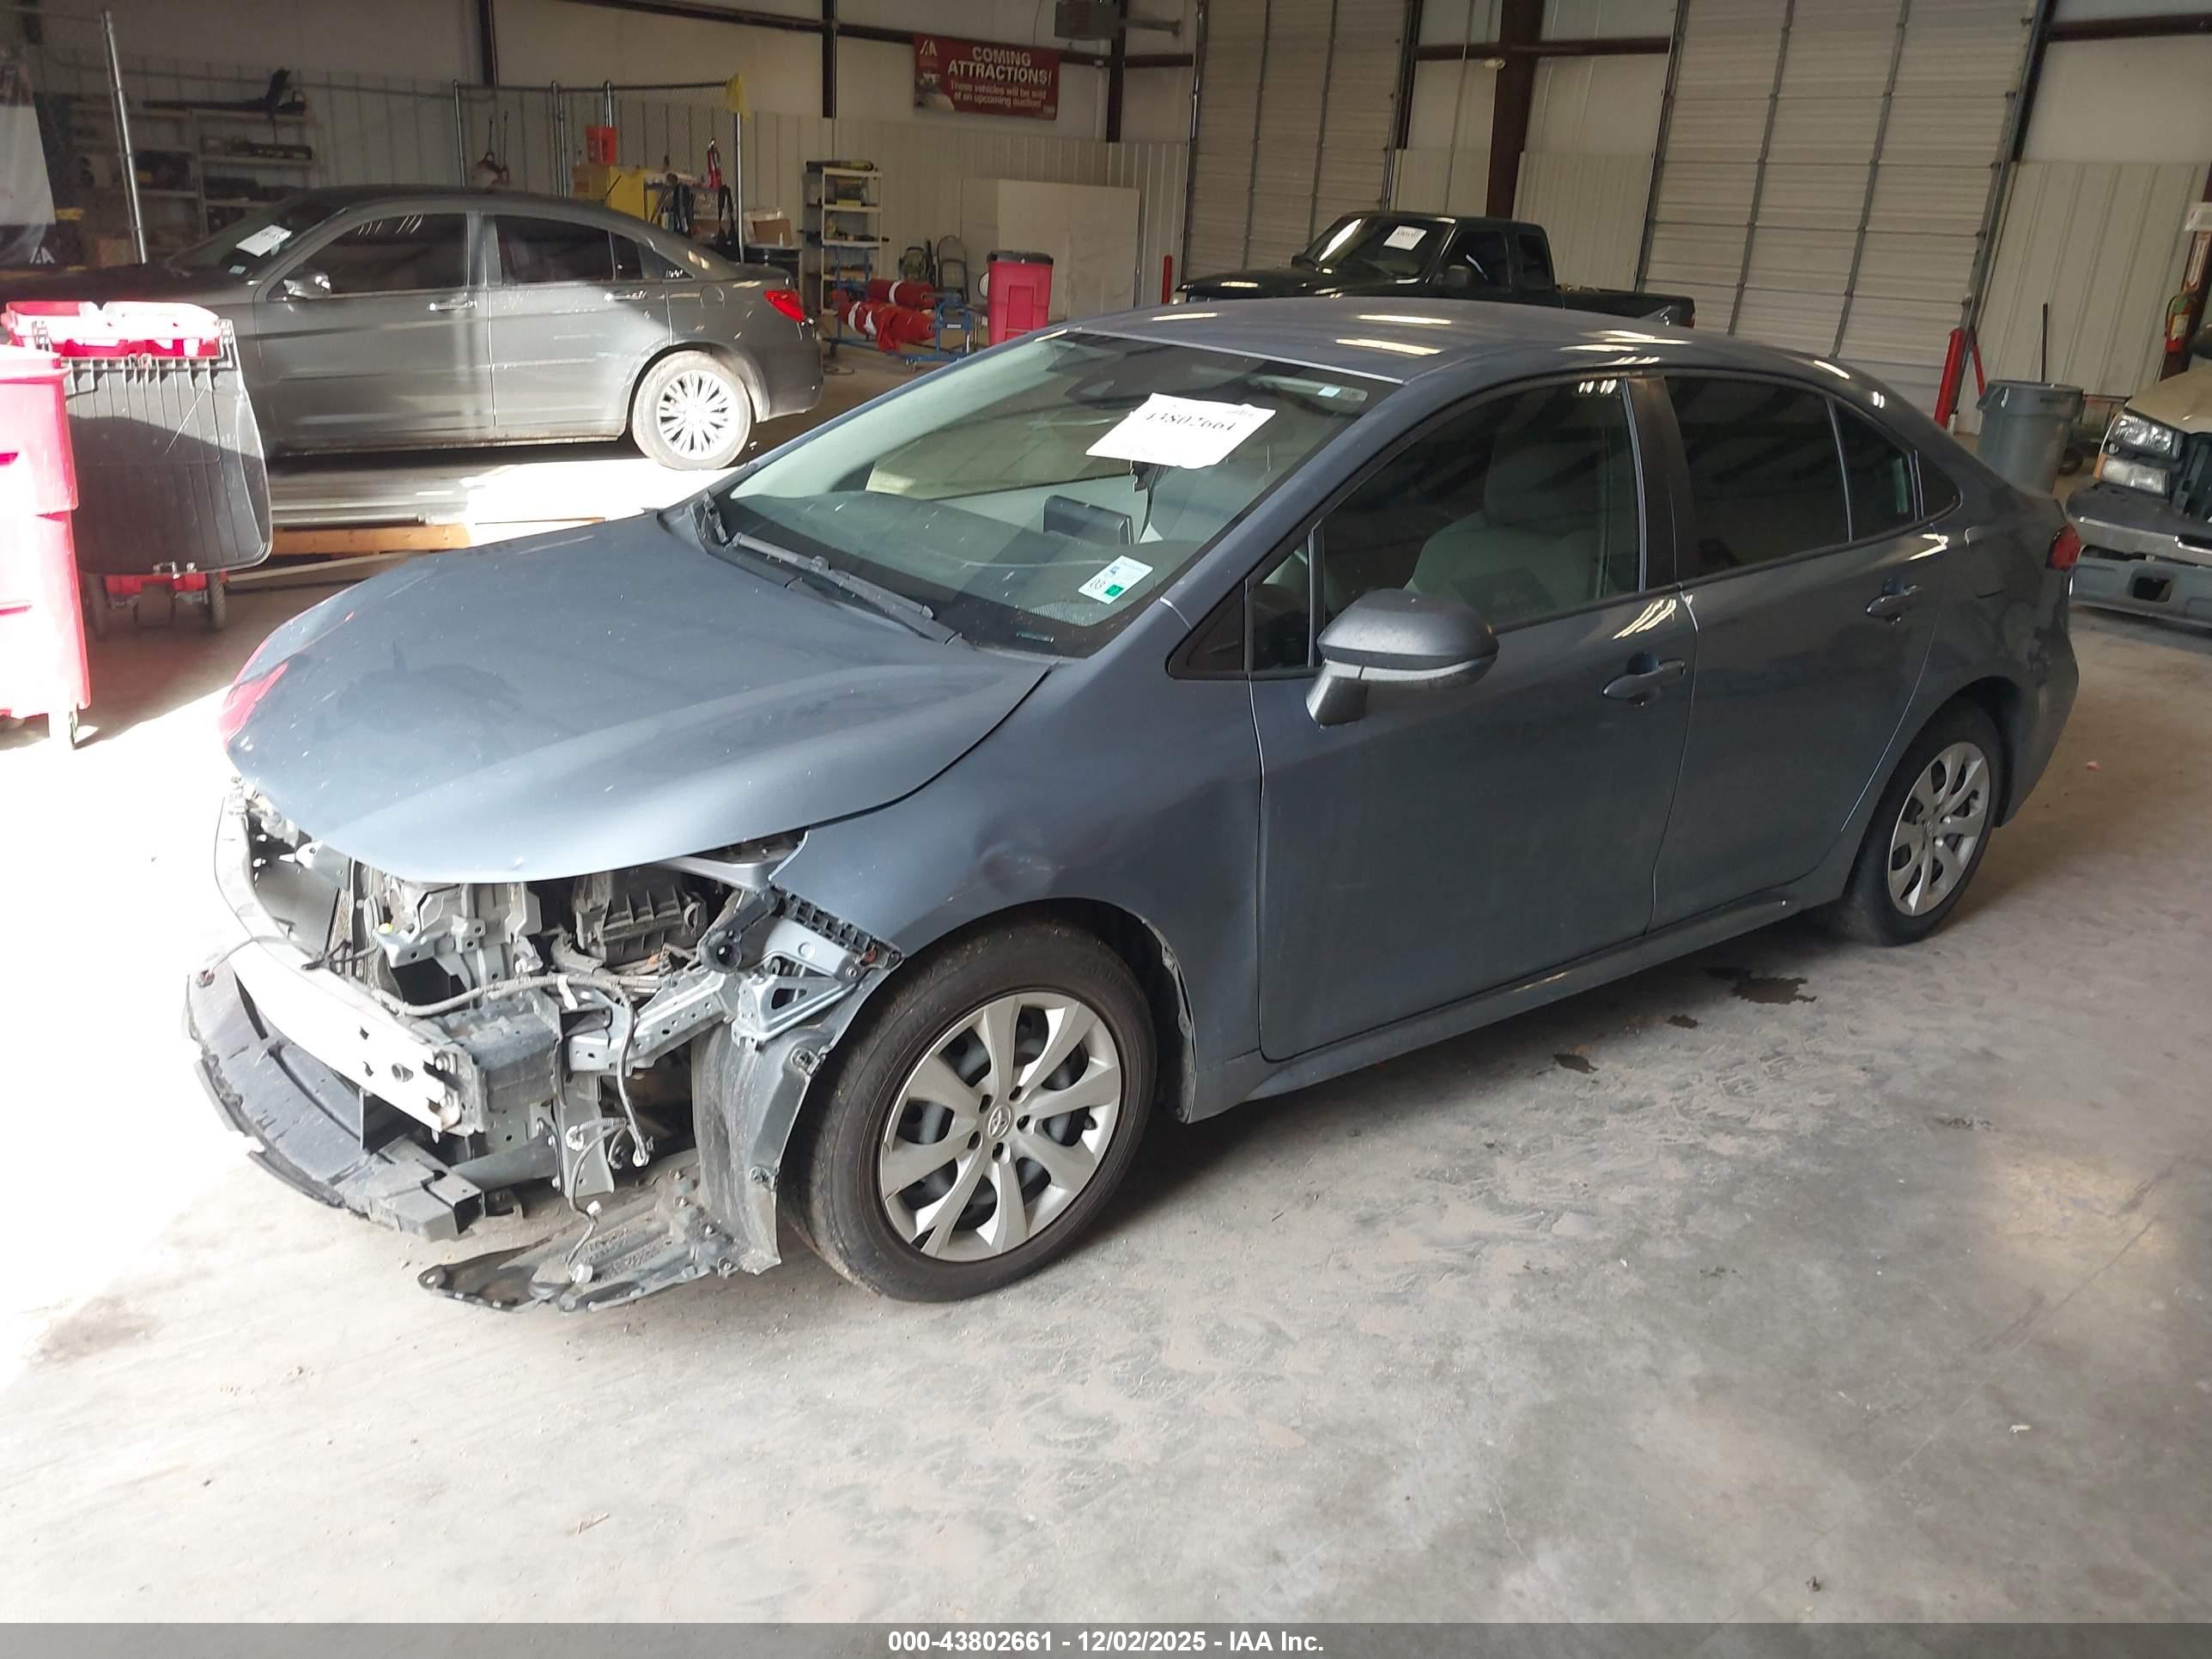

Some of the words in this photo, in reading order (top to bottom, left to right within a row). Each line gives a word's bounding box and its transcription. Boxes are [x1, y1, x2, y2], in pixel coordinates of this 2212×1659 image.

[972, 46, 1031, 67] COMING
[1006, 85, 1018, 97] will
[1019, 87, 1030, 98] be
[974, 94, 1012, 108] upcoming
